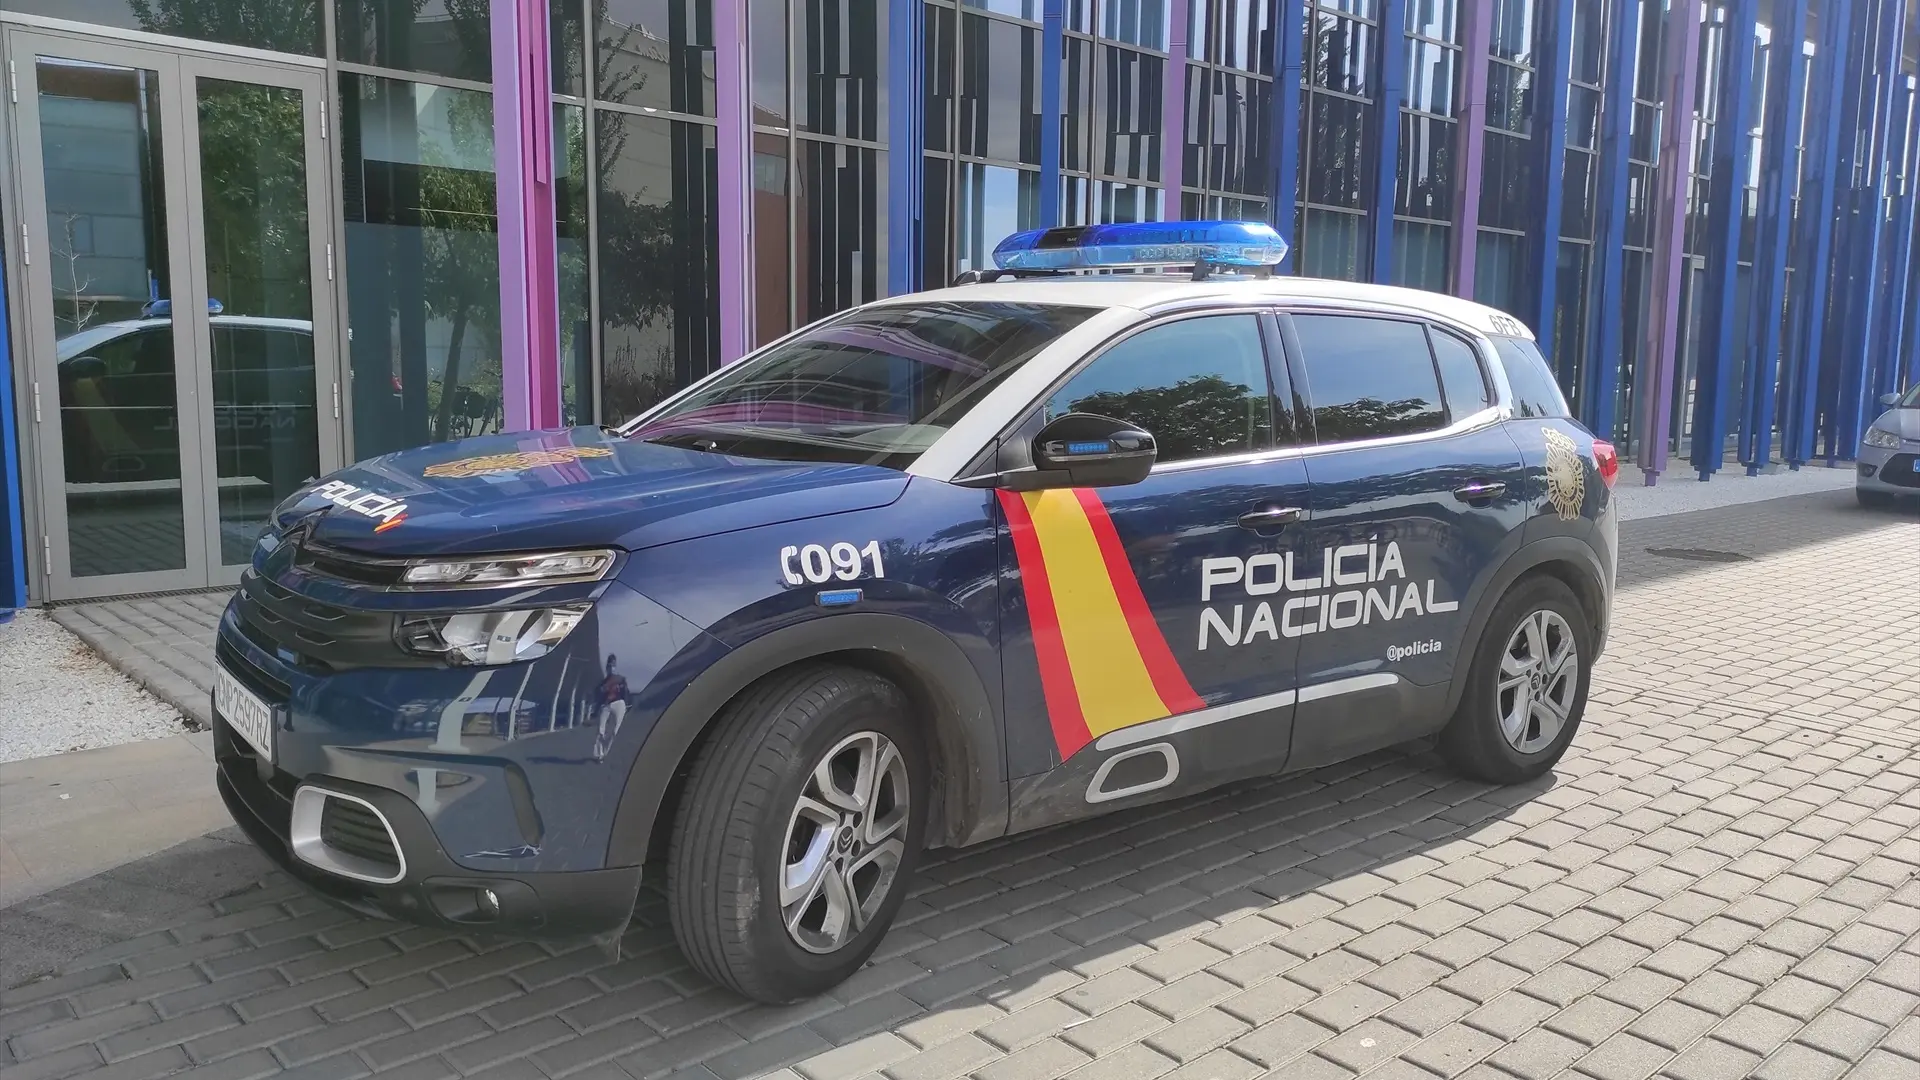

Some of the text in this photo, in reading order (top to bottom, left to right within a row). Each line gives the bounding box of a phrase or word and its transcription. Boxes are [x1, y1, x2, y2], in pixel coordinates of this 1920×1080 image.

[1488, 315, 1522, 337] 6FB
[310, 480, 408, 523] POLICÍA
[801, 540, 884, 583] 091
[1202, 534, 1406, 602] POLICÍA
[1198, 579, 1459, 650] NACIONAL
[1386, 639, 1442, 661] @policia
